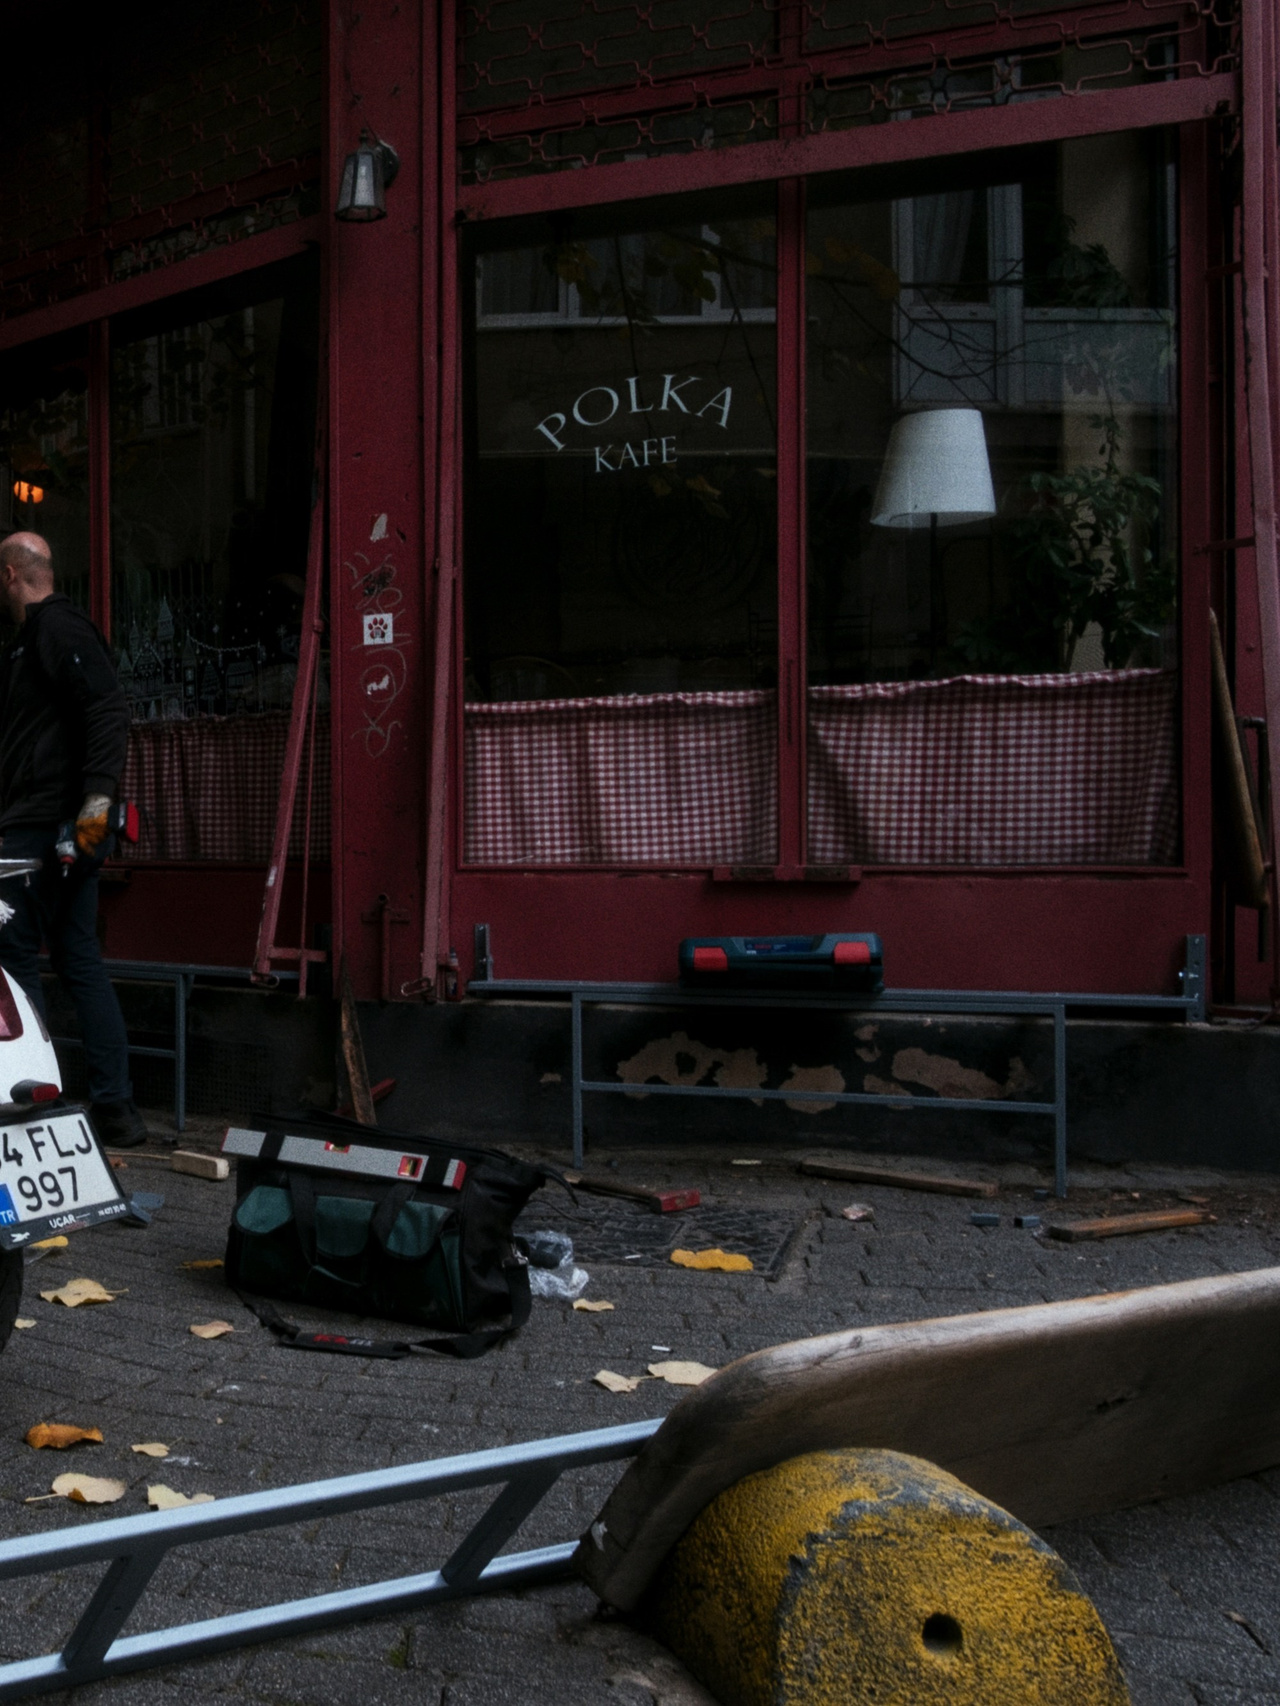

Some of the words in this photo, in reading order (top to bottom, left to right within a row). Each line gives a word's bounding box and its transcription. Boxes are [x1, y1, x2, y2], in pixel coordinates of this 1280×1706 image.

[534, 374, 733, 451] POLKA
[594, 436, 677, 473] KAFE
[25, 1119, 93, 1163] FLJ
[17, 1166, 79, 1212] 997
[0, 1210, 16, 1224] TR
